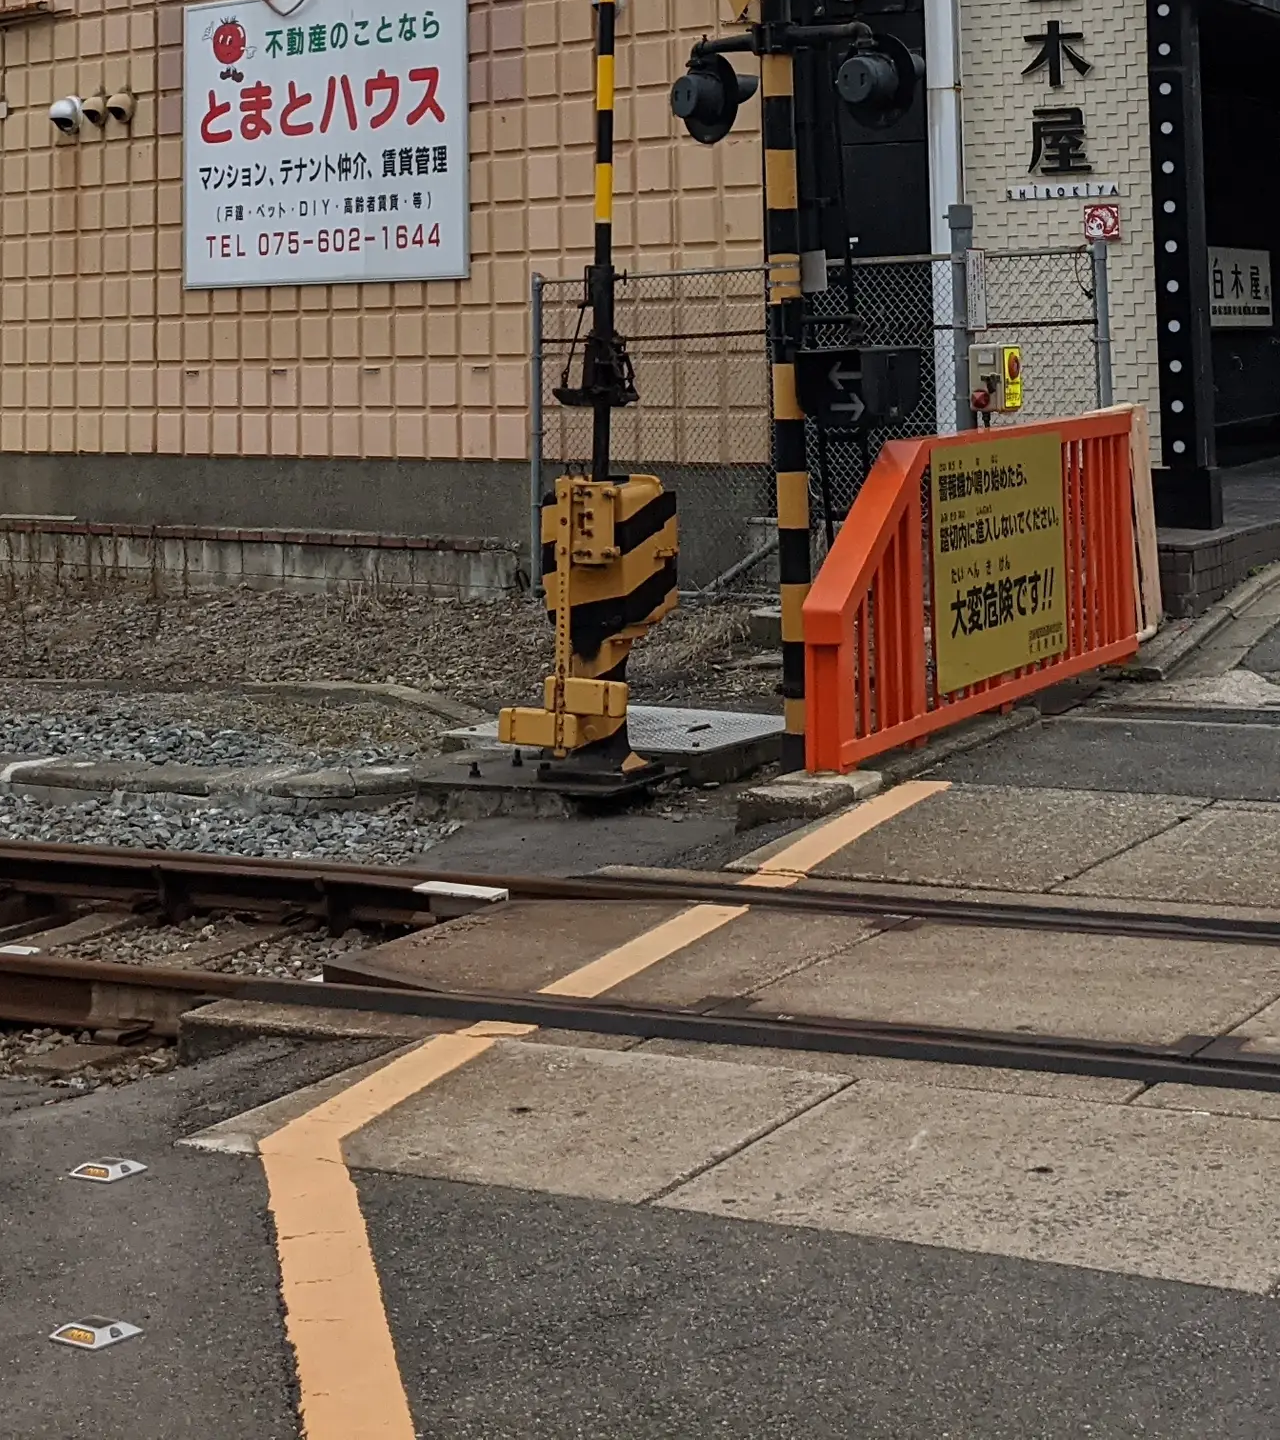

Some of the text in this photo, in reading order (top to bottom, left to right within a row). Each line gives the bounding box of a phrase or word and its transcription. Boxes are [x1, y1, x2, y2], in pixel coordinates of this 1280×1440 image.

[265, 10, 441, 59] 不動産のことなら
[200, 65, 446, 144] とまとハウス
[198, 145, 448, 190] マンション、テナント仲介、賃貸管理
[206, 223, 442, 258] TEL 075-602-1644
[1213, 258, 1261, 300] 白木屋
